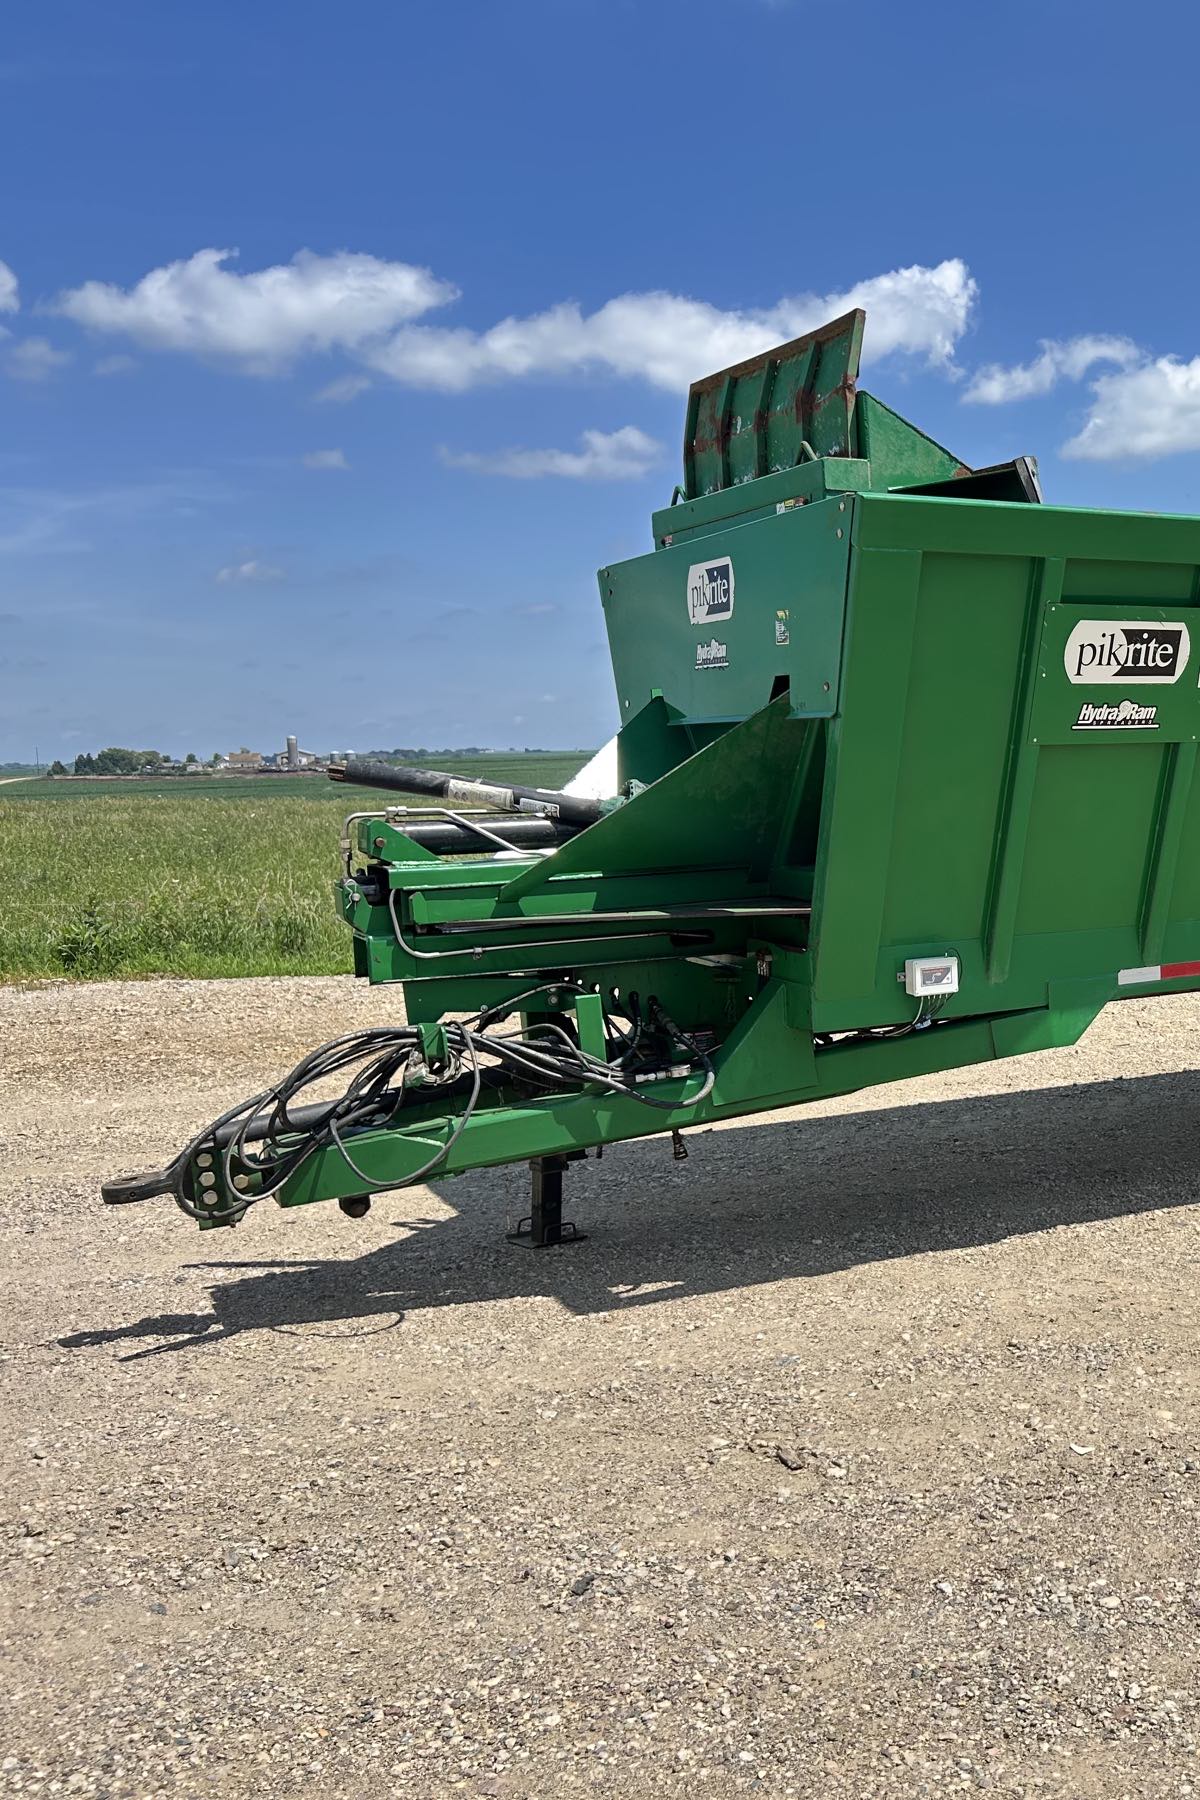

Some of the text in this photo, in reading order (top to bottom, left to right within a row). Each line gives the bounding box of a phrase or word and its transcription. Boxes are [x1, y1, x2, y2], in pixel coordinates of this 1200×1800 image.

[691, 571, 728, 618] pikrite
[1074, 632, 1173, 677] pikrite
[1078, 703, 1157, 724] Hydra Ram
